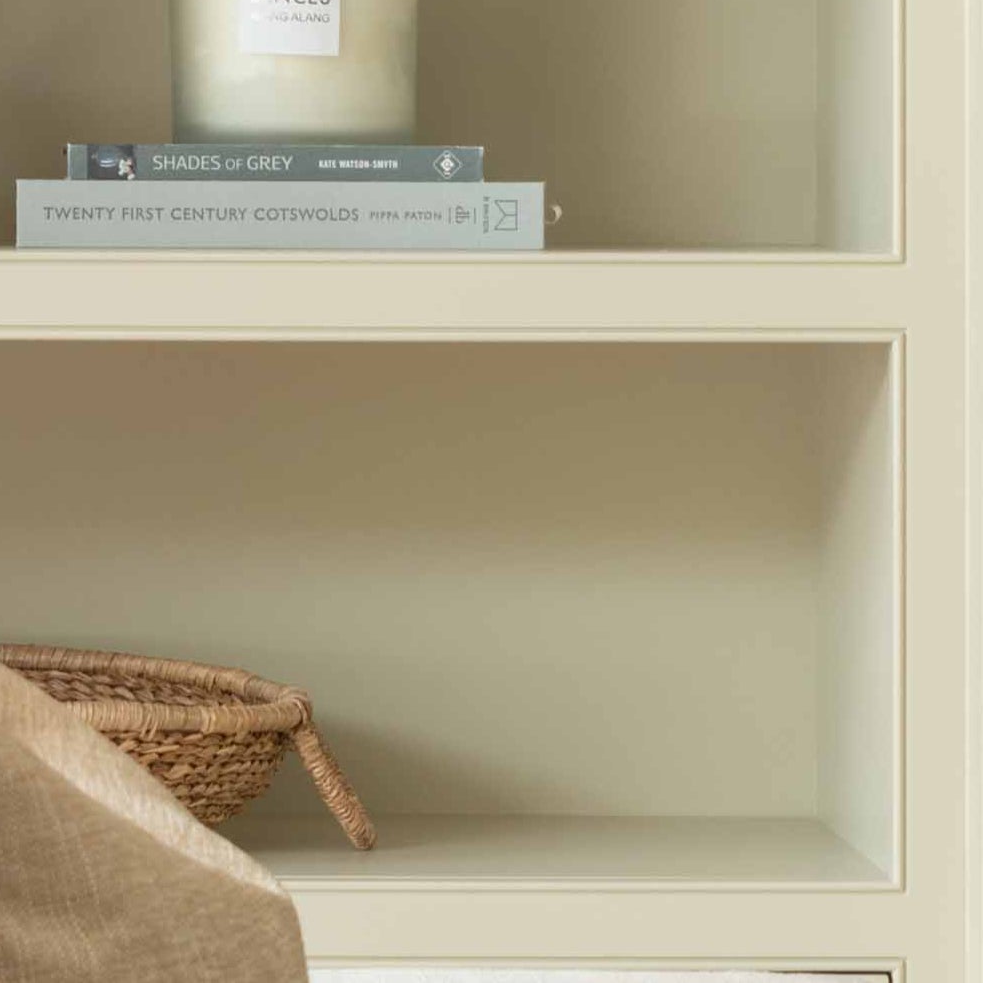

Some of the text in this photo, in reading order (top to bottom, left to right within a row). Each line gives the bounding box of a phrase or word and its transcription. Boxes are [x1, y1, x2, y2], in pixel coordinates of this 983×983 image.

[153, 155, 221, 170] SHADES
[247, 156, 293, 171] GREY
[318, 159, 398, 169] KATE WATSON-SMYTH
[43, 207, 359, 221] TWENTY FIRST CENTURY COTSWOLDS
[370, 210, 442, 220] PIPPA PATON
